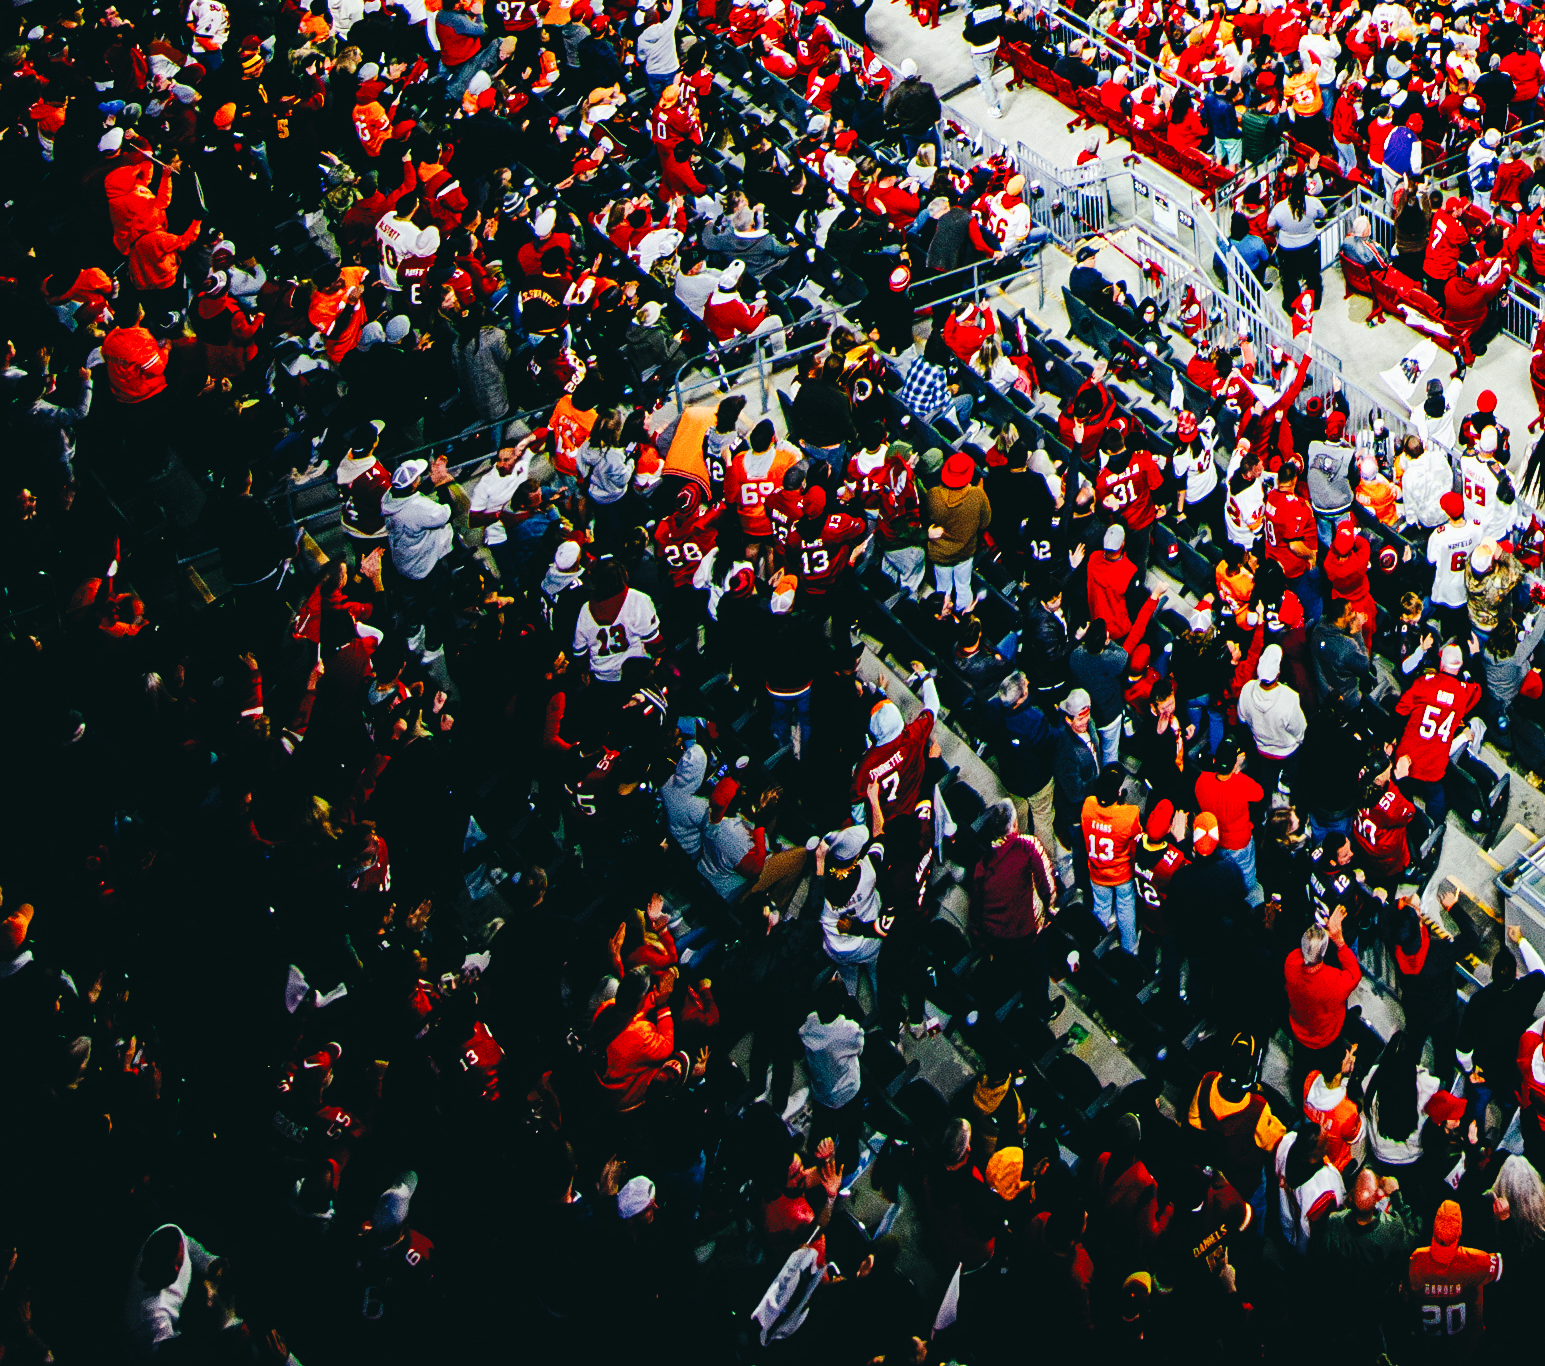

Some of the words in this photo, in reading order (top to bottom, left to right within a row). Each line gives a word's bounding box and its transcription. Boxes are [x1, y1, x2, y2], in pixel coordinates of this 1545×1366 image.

[497, 2, 525, 20] 87
[1109, 480, 1137, 511] 31
[665, 543, 702, 566] 28
[802, 551, 828, 573] 13
[1031, 541, 1051, 559] 12
[1420, 706, 1455, 742] 54
[882, 772, 899, 801] 7
[1089, 835, 1113, 860] 13
[460, 1050, 478, 1071] 13
[1420, 1302, 1467, 1335] 20
